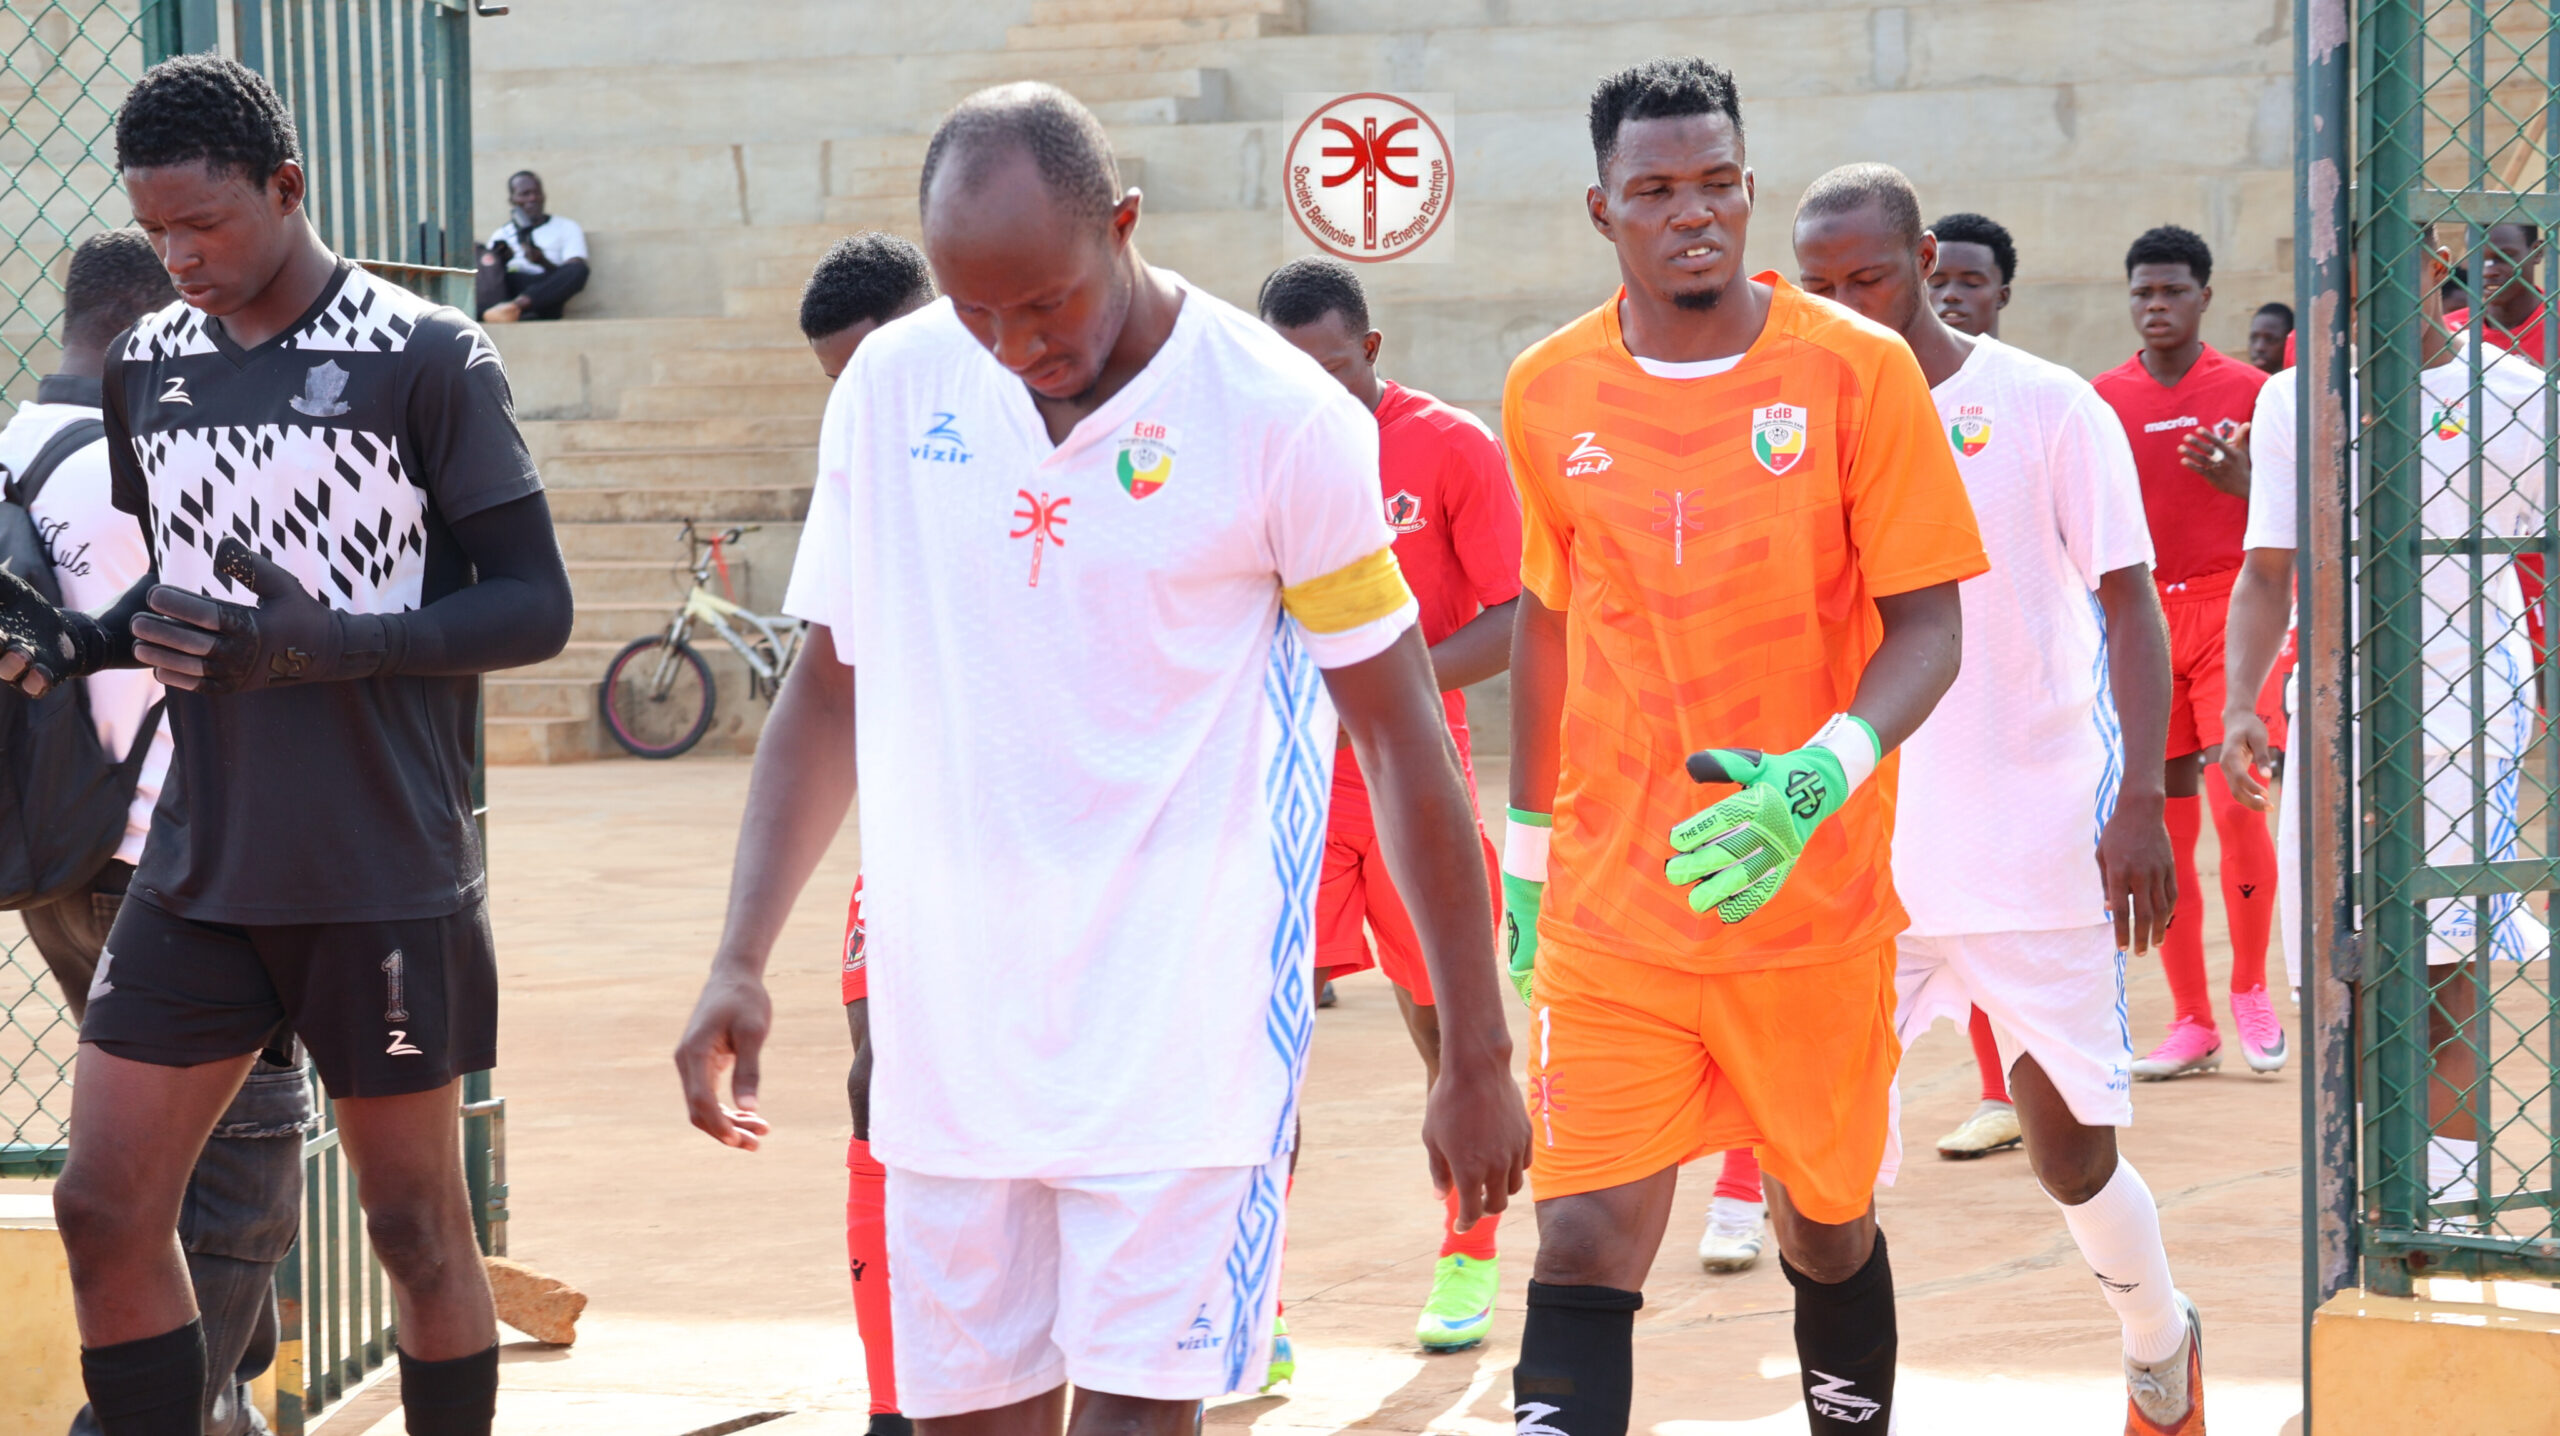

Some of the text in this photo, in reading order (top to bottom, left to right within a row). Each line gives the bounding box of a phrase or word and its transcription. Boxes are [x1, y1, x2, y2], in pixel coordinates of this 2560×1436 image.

[1765, 407, 1792, 419] EdB
[1960, 406, 1983, 415] EdB
[1134, 421, 1167, 440] EdB
[910, 444, 974, 463] vizir
[1679, 815, 1718, 841] THE BEST
[2441, 928, 2478, 937] vizi
[382, 949, 409, 1021] 1
